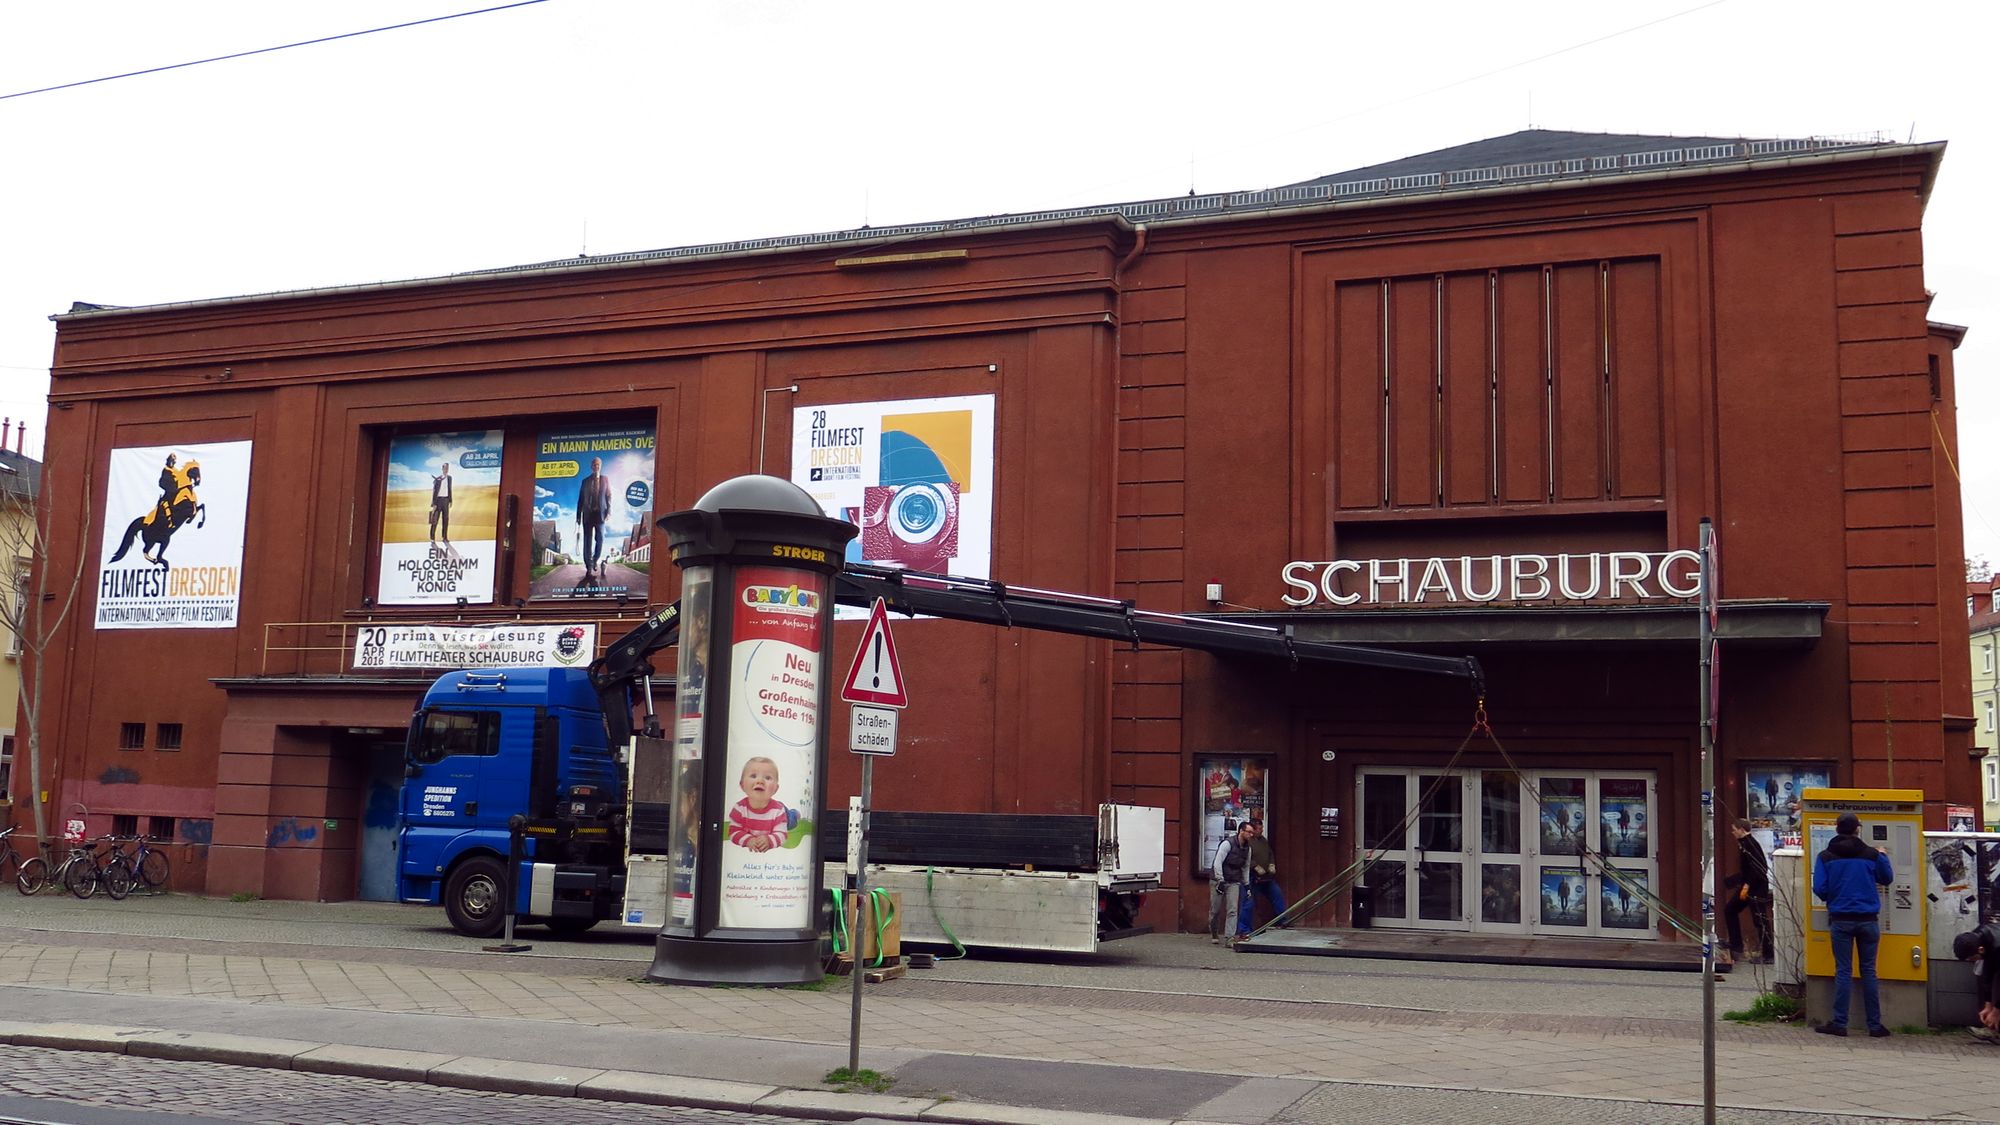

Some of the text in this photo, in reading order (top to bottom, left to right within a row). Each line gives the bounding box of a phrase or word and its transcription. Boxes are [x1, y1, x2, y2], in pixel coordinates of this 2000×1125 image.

[812, 410, 826, 429] 28
[542, 442, 557, 454] EIN
[559, 440, 589, 454] MANN
[591, 437, 632, 451] NAMENS
[635, 436, 656, 449] OVE
[811, 427, 864, 448] FILMFEST
[810, 446, 862, 467] DRESDEN
[824, 465, 861, 475] INTERNATIONAL
[429, 548, 448, 560] EIN
[398, 558, 479, 571] HOLOGRAMM
[101, 566, 238, 598] FILMFEST DRESDEN
[437, 570, 463, 581] DEN
[1281, 549, 1700, 607] SCHAUBURG
[98, 606, 233, 622] INTERNATIONAL SHORT FILM FESTIVAL
[657, 606, 677, 623] HIAB
[782, 618, 809, 632] Anfang
[364, 627, 387, 647] 20
[392, 630, 436, 644] prima
[490, 630, 546, 645] lesung
[362, 646, 385, 657] APR
[389, 650, 545, 664] FILMTHEATER SCHAUBURG
[361, 656, 385, 666] 2016
[785, 653, 812, 674] Neu
[771, 673, 815, 691] in Dresden
[761, 704, 798, 720] Straße
[857, 713, 892, 729] Straßen-
[857, 733, 890, 747] schäden
[1832, 802, 1893, 811] Fahrausweise
